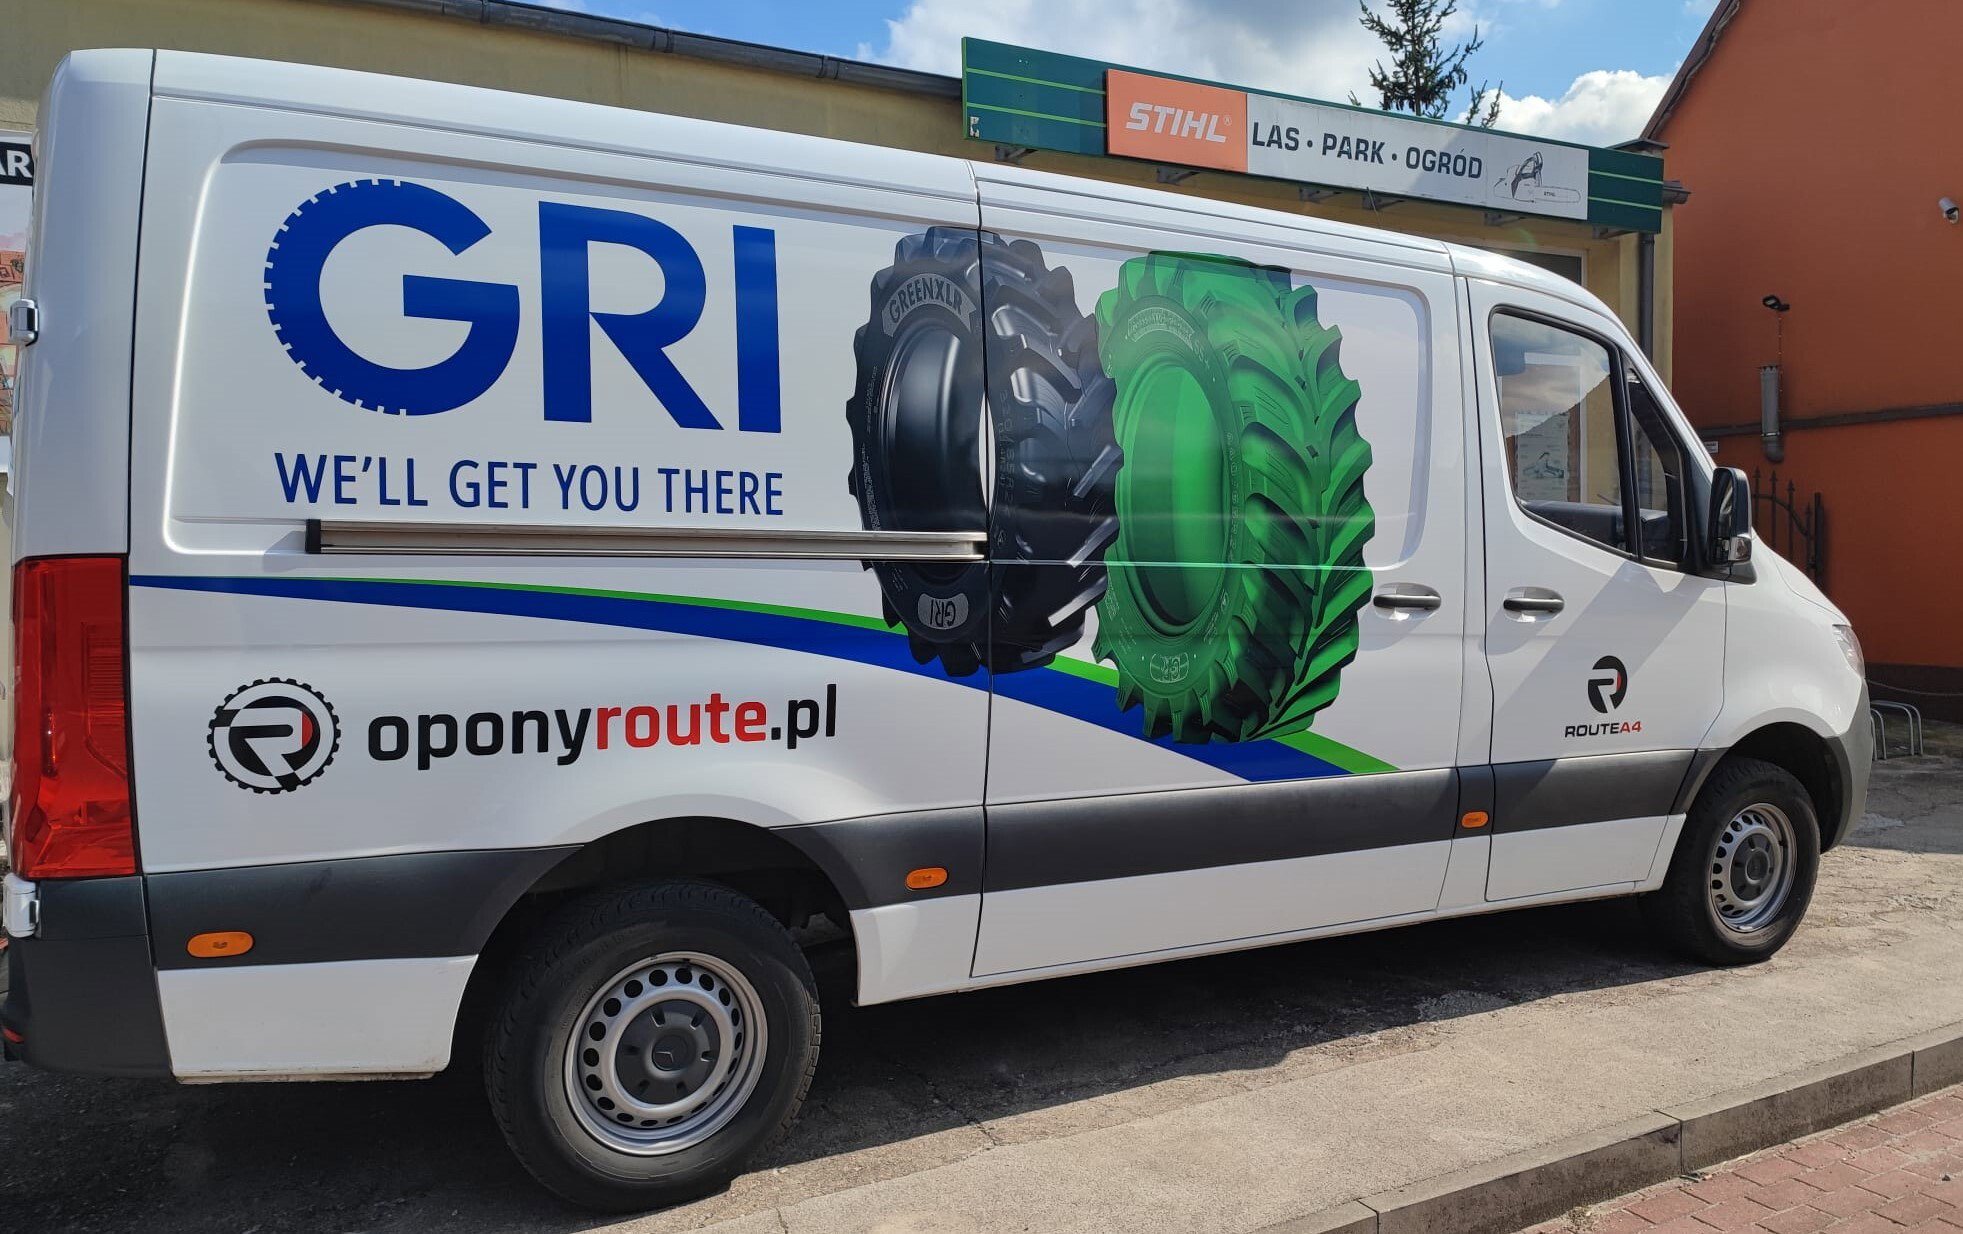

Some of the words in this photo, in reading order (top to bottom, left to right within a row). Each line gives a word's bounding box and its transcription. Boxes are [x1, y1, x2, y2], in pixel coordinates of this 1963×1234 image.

[1125, 102, 1227, 143] STIHL
[1252, 122, 1300, 151] LAS
[1322, 133, 1386, 165] PARK
[1405, 147, 1483, 179] OGRÓD
[263, 178, 782, 434] GRI
[275, 452, 429, 507] WE'LL
[449, 459, 538, 510] GET
[553, 463, 640, 512] YOU
[657, 467, 784, 516] THERE
[929, 599, 957, 628] GRI
[367, 683, 838, 772] oponyroute.pl
[1564, 720, 1643, 738] ROUTEA4
